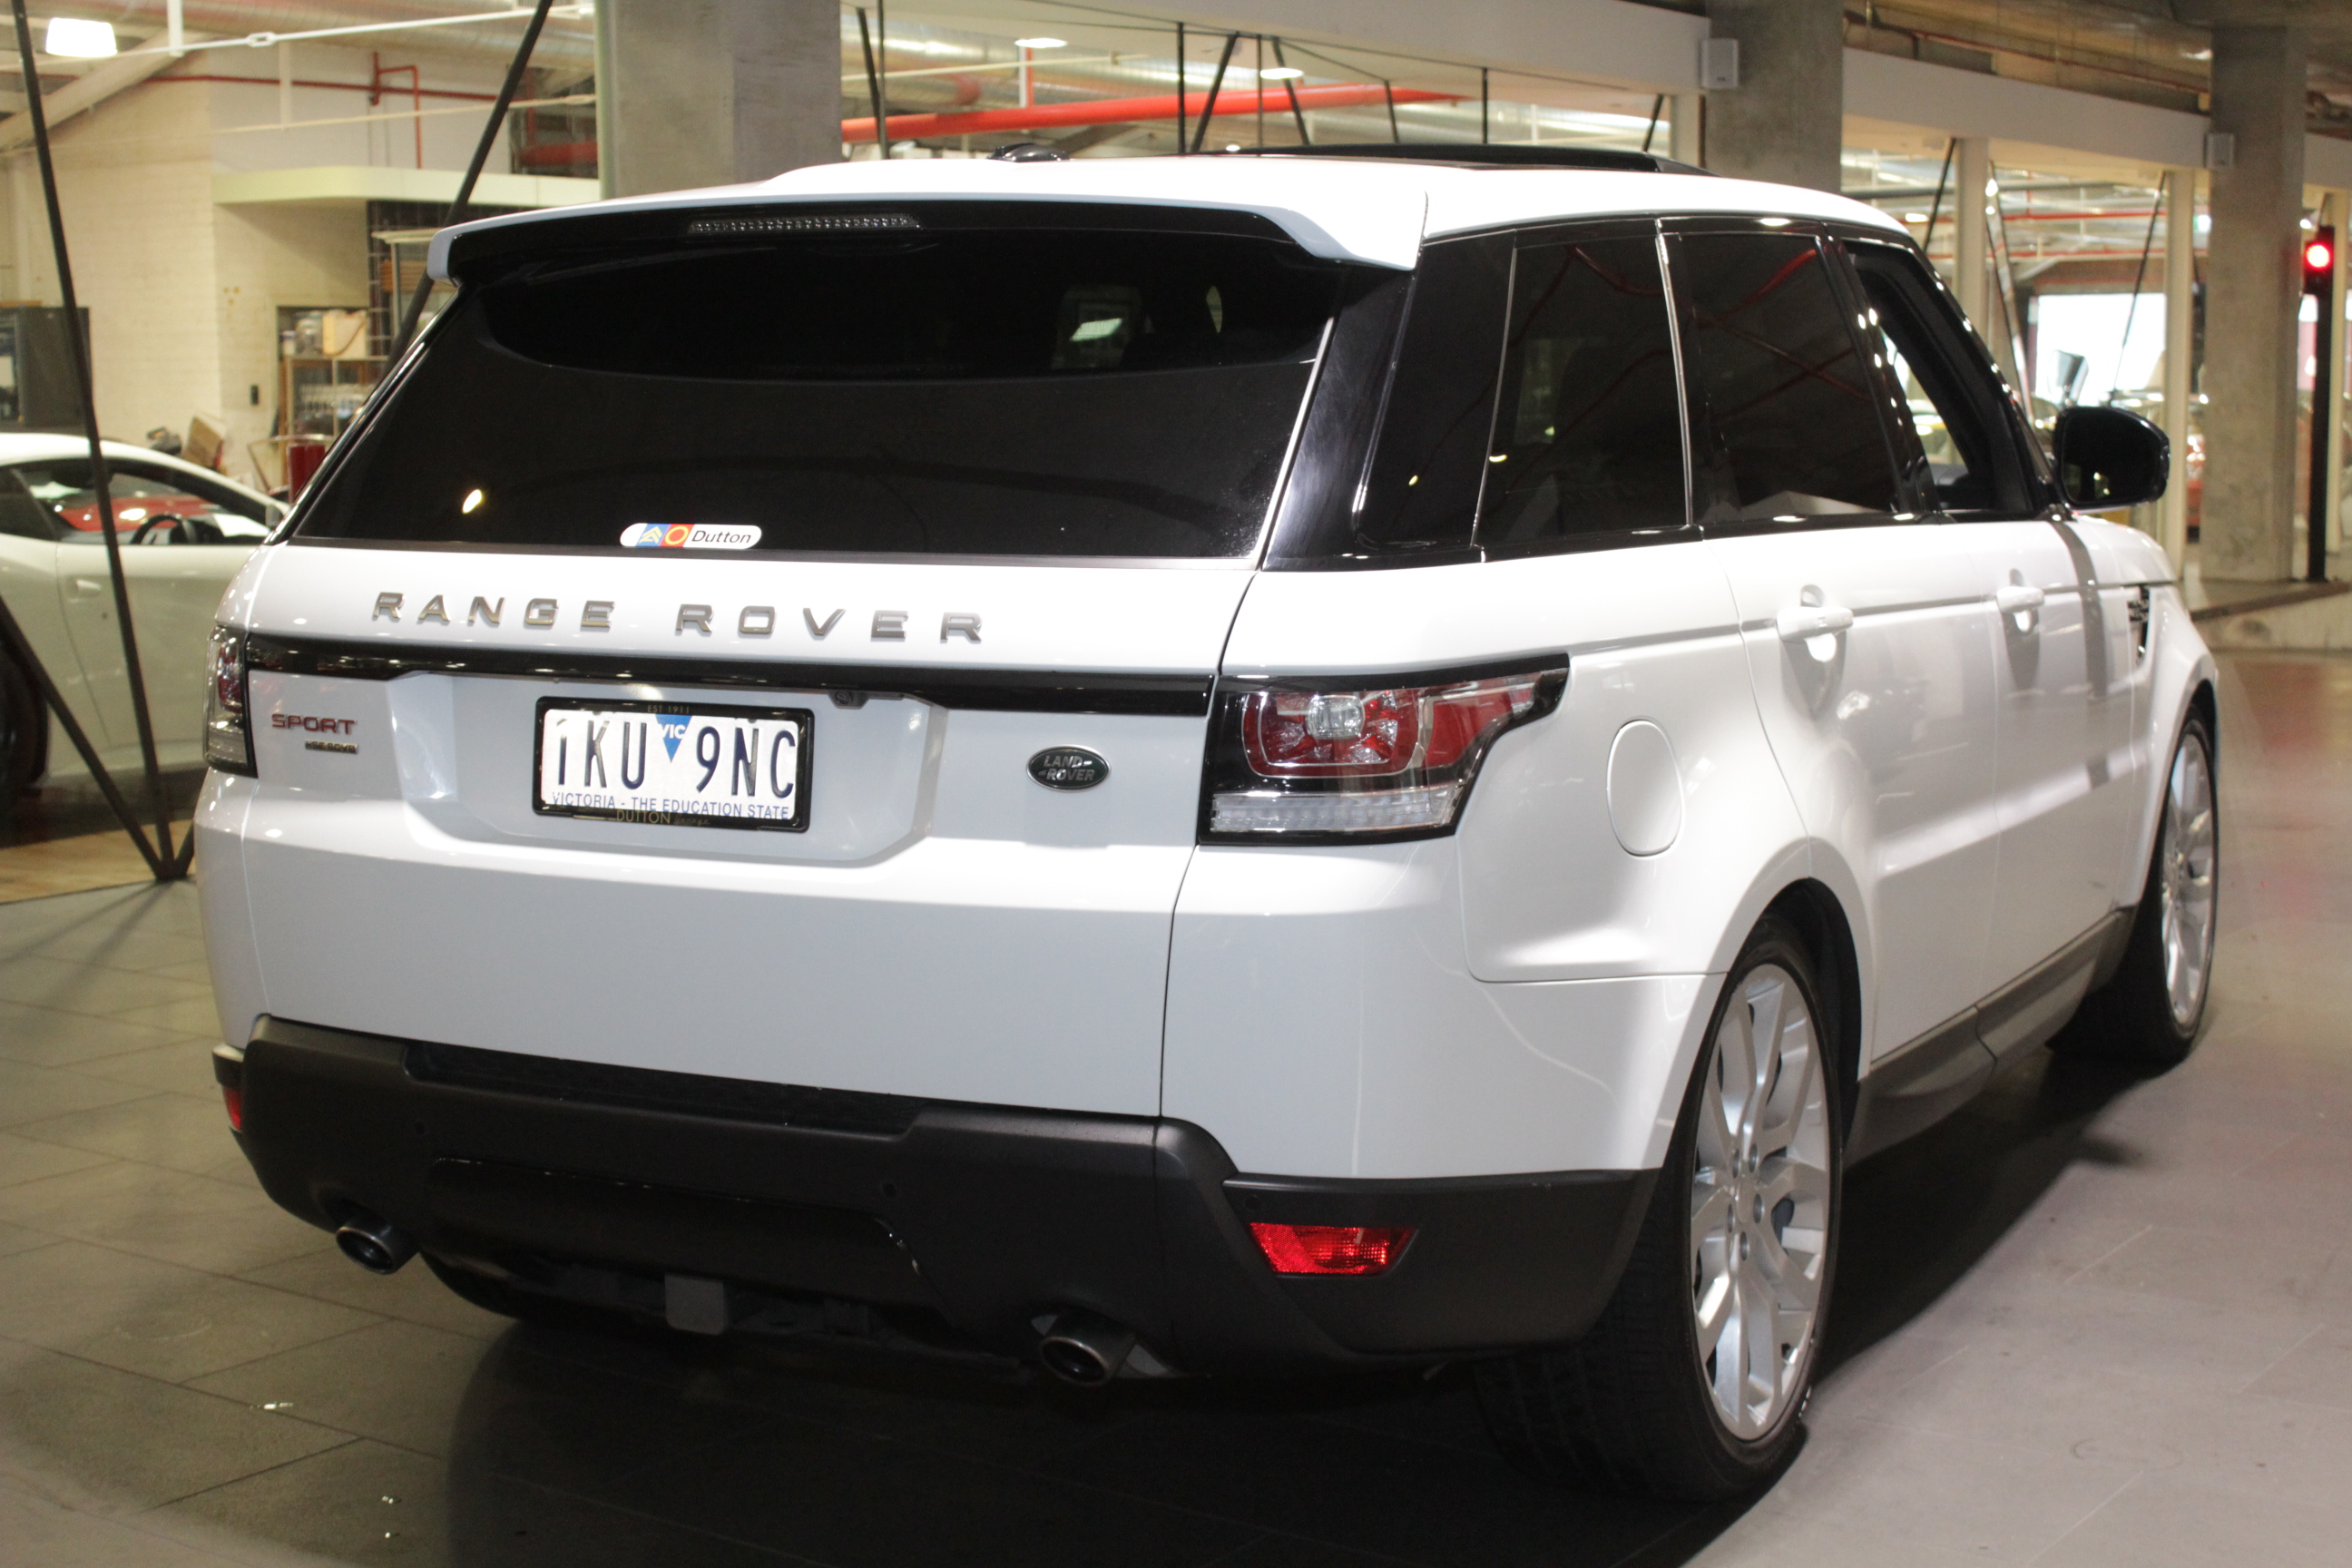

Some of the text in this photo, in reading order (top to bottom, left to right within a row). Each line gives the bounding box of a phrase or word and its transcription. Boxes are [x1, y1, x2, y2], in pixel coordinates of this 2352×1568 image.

[691, 530, 751, 544] Dutton
[373, 592, 983, 642] RANGE ROVER
[647, 704, 690, 714] EST 1911
[271, 714, 356, 735] SPORT
[662, 724, 686, 739] VIC
[556, 719, 796, 799] 1KU 9NC
[1044, 755, 1083, 768] LAND
[1046, 768, 1095, 781] ROVER
[552, 792, 616, 810] VICTORIA
[631, 797, 658, 812] THE
[662, 799, 743, 818] EDUCATION
[747, 804, 789, 820] STATE
[616, 809, 671, 825] DUTTON
